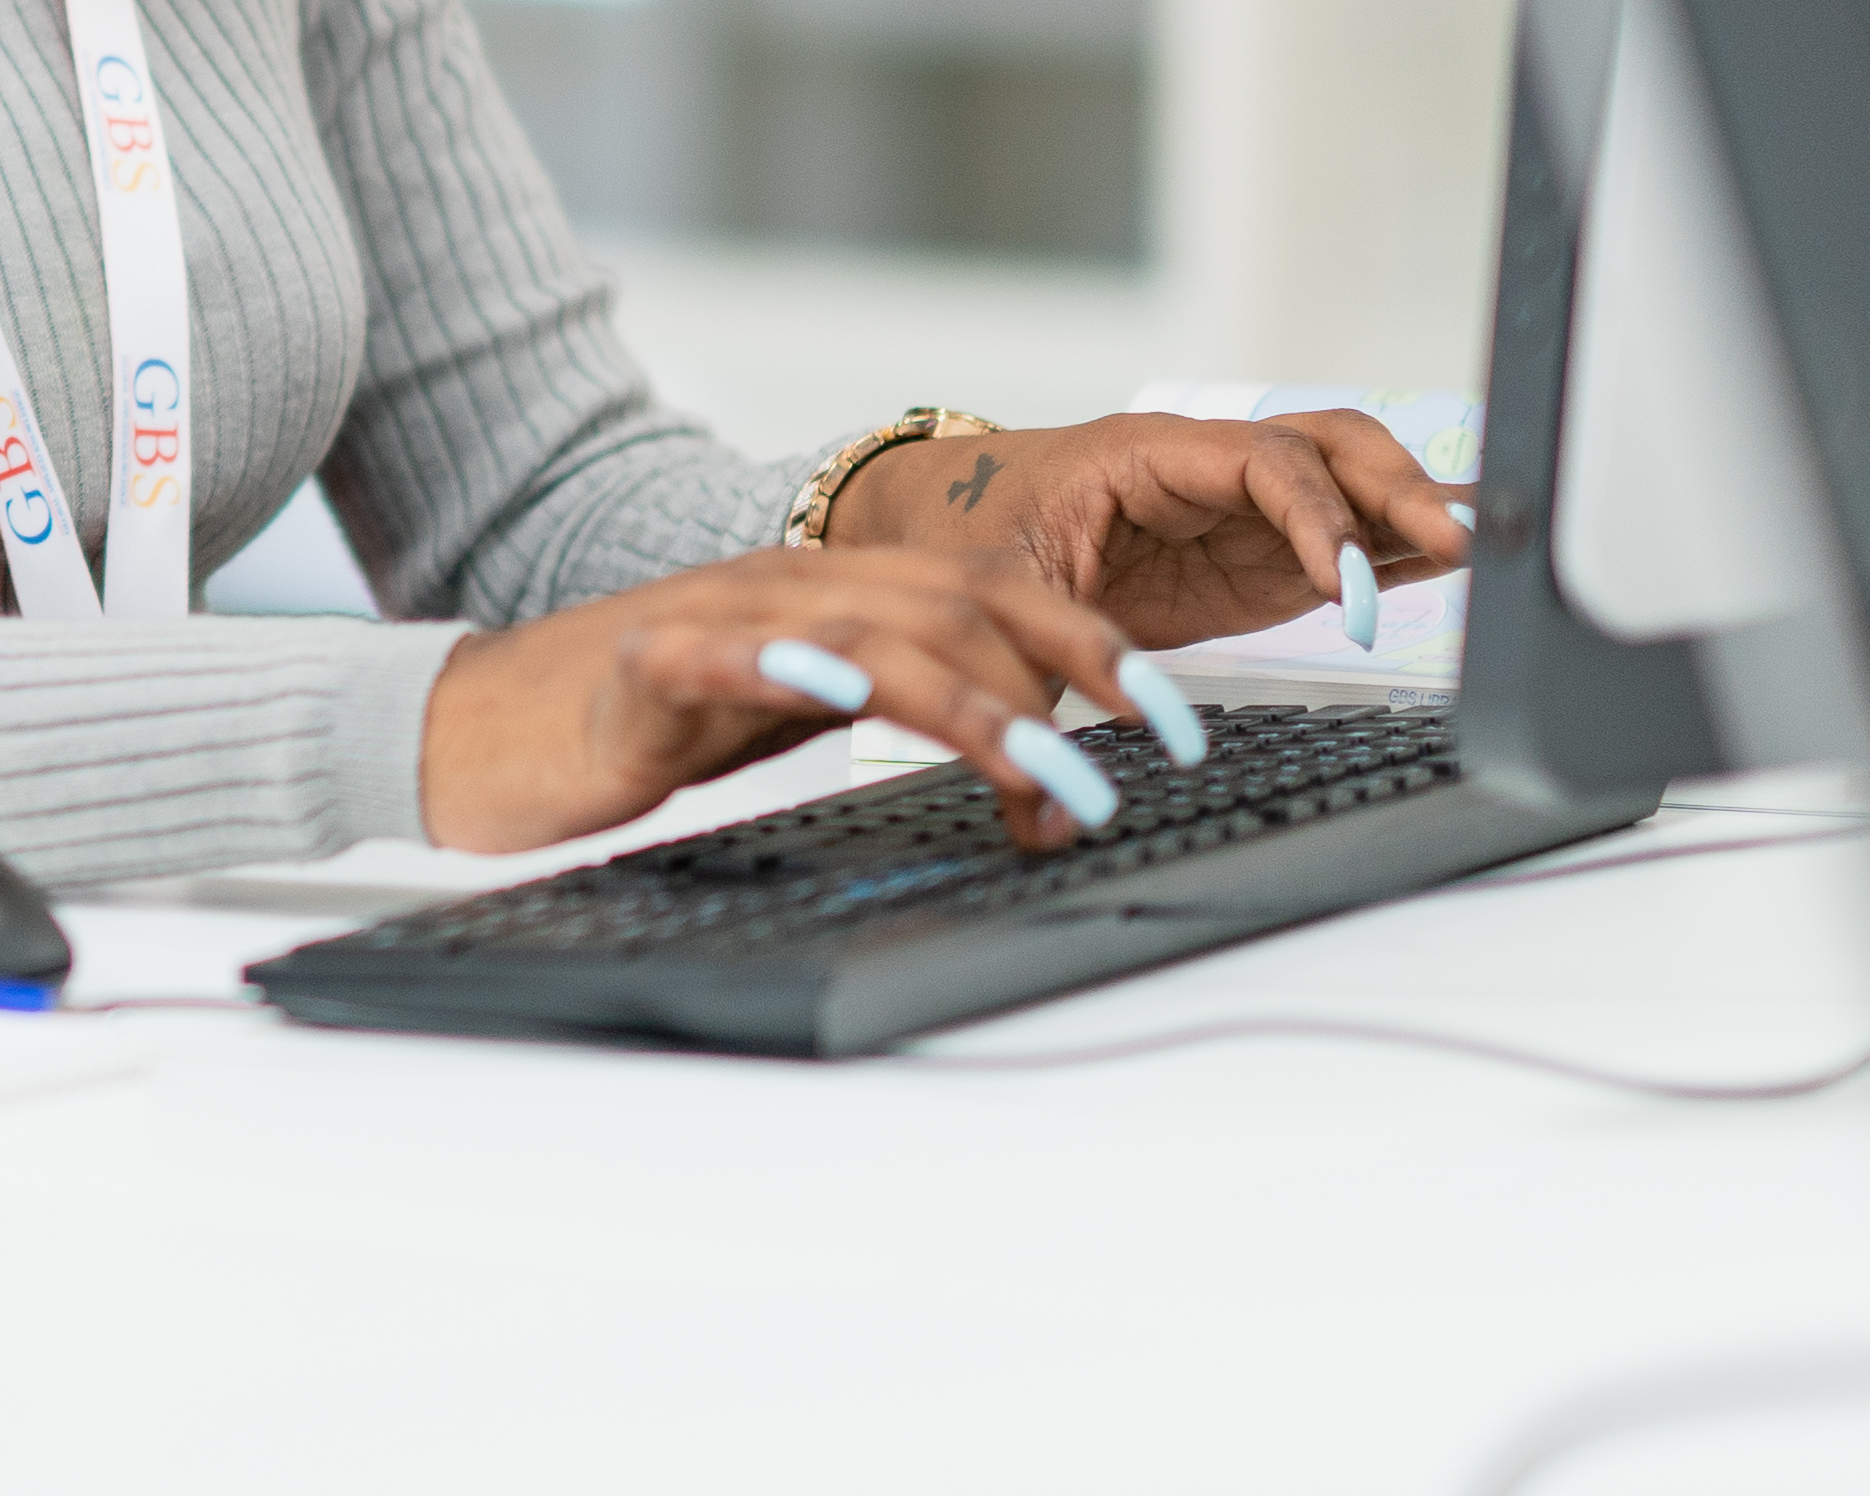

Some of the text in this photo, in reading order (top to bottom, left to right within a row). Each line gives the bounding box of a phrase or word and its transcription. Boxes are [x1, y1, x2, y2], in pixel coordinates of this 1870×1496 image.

[95, 55, 161, 193] GBS
[131, 358, 181, 508] GBS
[1388, 688, 1417, 706] GBS
